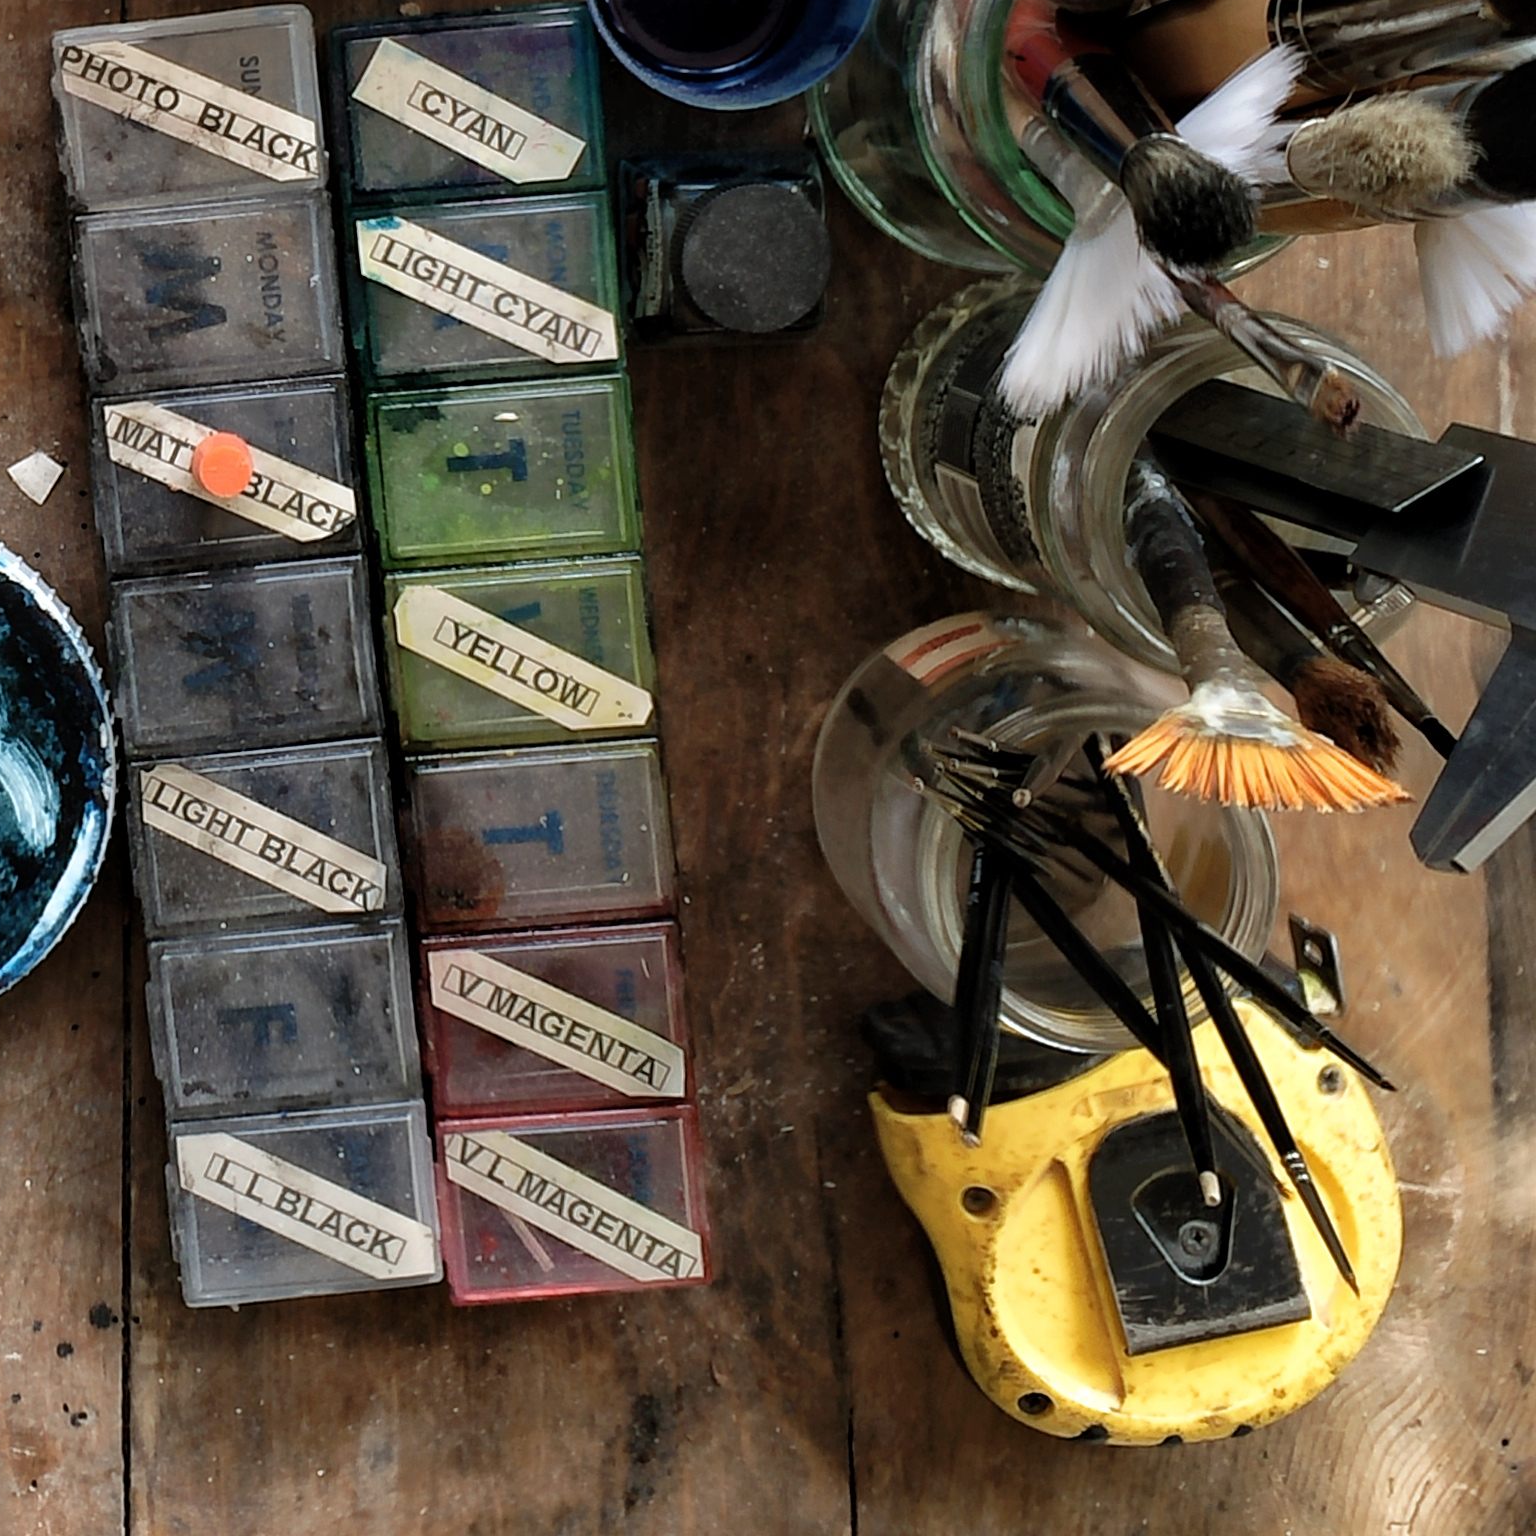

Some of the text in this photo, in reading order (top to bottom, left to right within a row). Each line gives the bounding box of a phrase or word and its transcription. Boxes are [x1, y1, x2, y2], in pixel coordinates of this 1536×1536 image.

[62, 45, 320, 173] PHOTO BLACK
[420, 87, 517, 154] CYAN
[255, 231, 288, 344] MONDAY
[382, 238, 592, 351] LIGHT CYAN
[115, 419, 353, 531] MAT BLACK
[446, 437, 528, 482] T
[562, 409, 591, 512] TUESDAY
[451, 619, 591, 710] YELLOW
[151, 780, 255, 848] LIGHT
[258, 830, 378, 910] BLACK
[483, 810, 564, 856] T
[457, 968, 659, 1088] V MAGENTA
[214, 1158, 396, 1263] L L BLACK
[460, 1137, 681, 1281] V L MAGENTA
